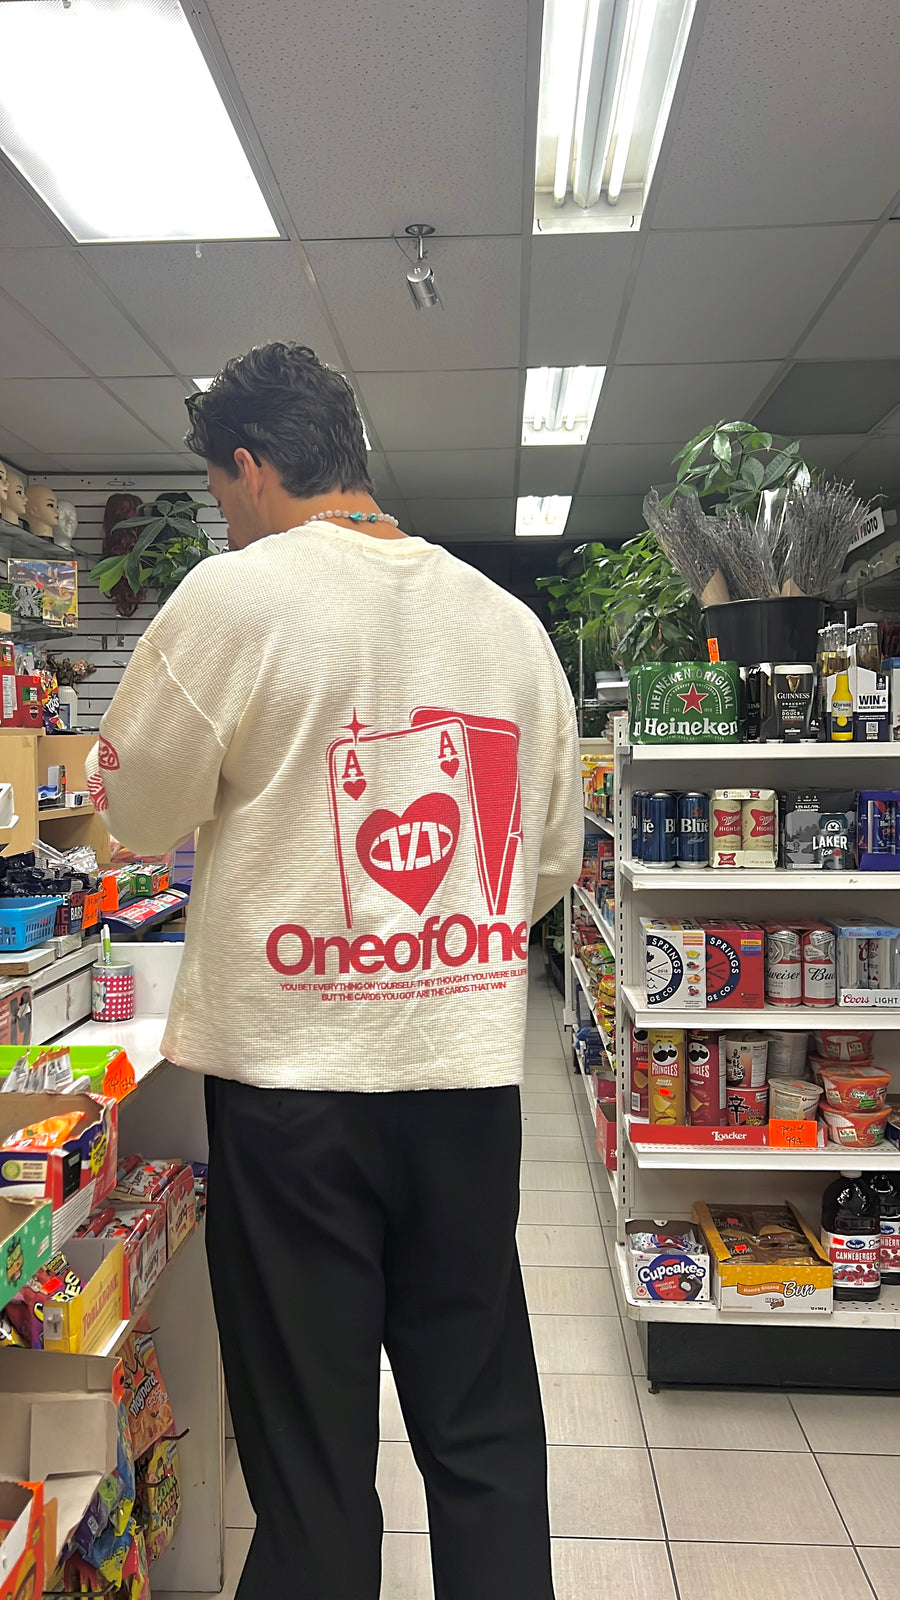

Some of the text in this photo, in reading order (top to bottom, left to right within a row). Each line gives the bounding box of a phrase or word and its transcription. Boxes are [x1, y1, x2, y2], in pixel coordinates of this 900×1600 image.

[650, 668, 691, 710] HEINEKEN
[696, 670, 734, 709] ORIGINAL
[777, 692, 810, 700] GUINNESS
[858, 695, 880, 705] WIN
[644, 717, 738, 736] Heineken
[438, 730, 458, 759] A
[341, 750, 364, 779] A
[812, 835, 848, 850] LAKER
[266, 913, 527, 976] OneofOne
[652, 938, 681, 974] SPRINGS
[710, 937, 739, 974] SPRINGS
[280, 983, 297, 991] YOU
[298, 983, 313, 991] BET
[314, 982, 363, 991] EVERYTHING
[417, 978, 436, 988] THEY
[437, 974, 470, 985] THOUGHT
[471, 972, 488, 981] YOU
[488, 970, 509, 979] WERE
[768, 969, 800, 980] weiser
[321, 981, 507, 1001] BUT THE CARDS YOU GOT ARE THE CARDS THAT WIN
[843, 993, 870, 1004] Coors
[651, 1062, 678, 1077] PRINGLES
[711, 1131, 748, 1141] Loacker
[640, 1261, 705, 1282] Cupcakes
[782, 1281, 816, 1298] Bun
